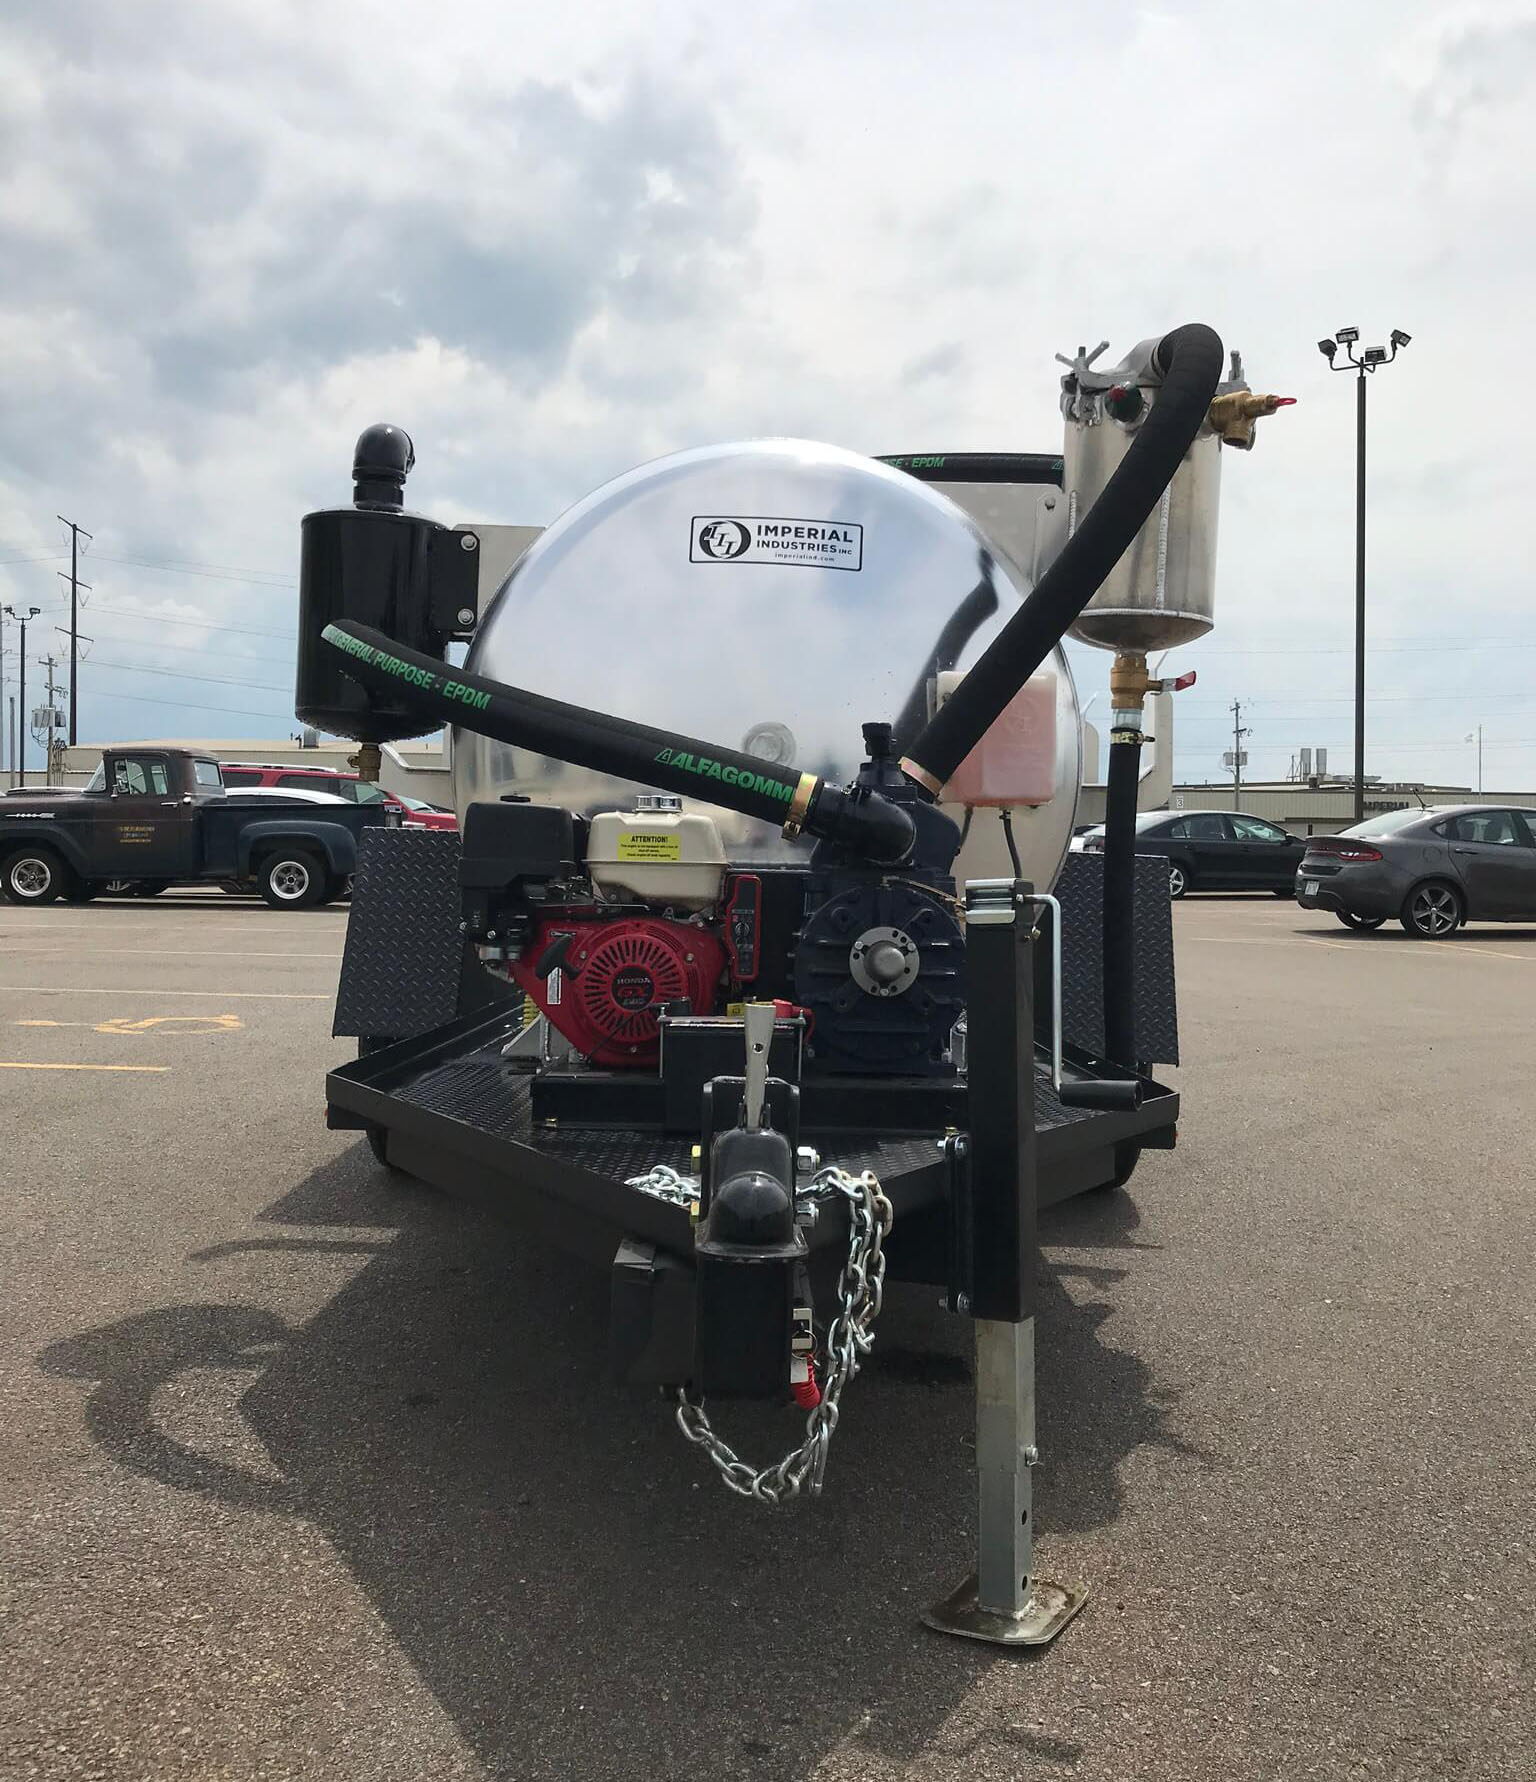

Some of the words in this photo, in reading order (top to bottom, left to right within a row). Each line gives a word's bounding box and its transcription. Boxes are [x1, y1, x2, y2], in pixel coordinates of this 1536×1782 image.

[911, 457, 945, 468] EPDM
[757, 525, 853, 543] IMPERIAL
[757, 540, 838, 554] INDUSTRIES
[774, 552, 835, 562] imperialind.com
[335, 633, 374, 663] GENERAL
[373, 651, 435, 689] PURPOSE
[442, 681, 492, 710] EPDM
[631, 835, 669, 843] ATTENTION!
